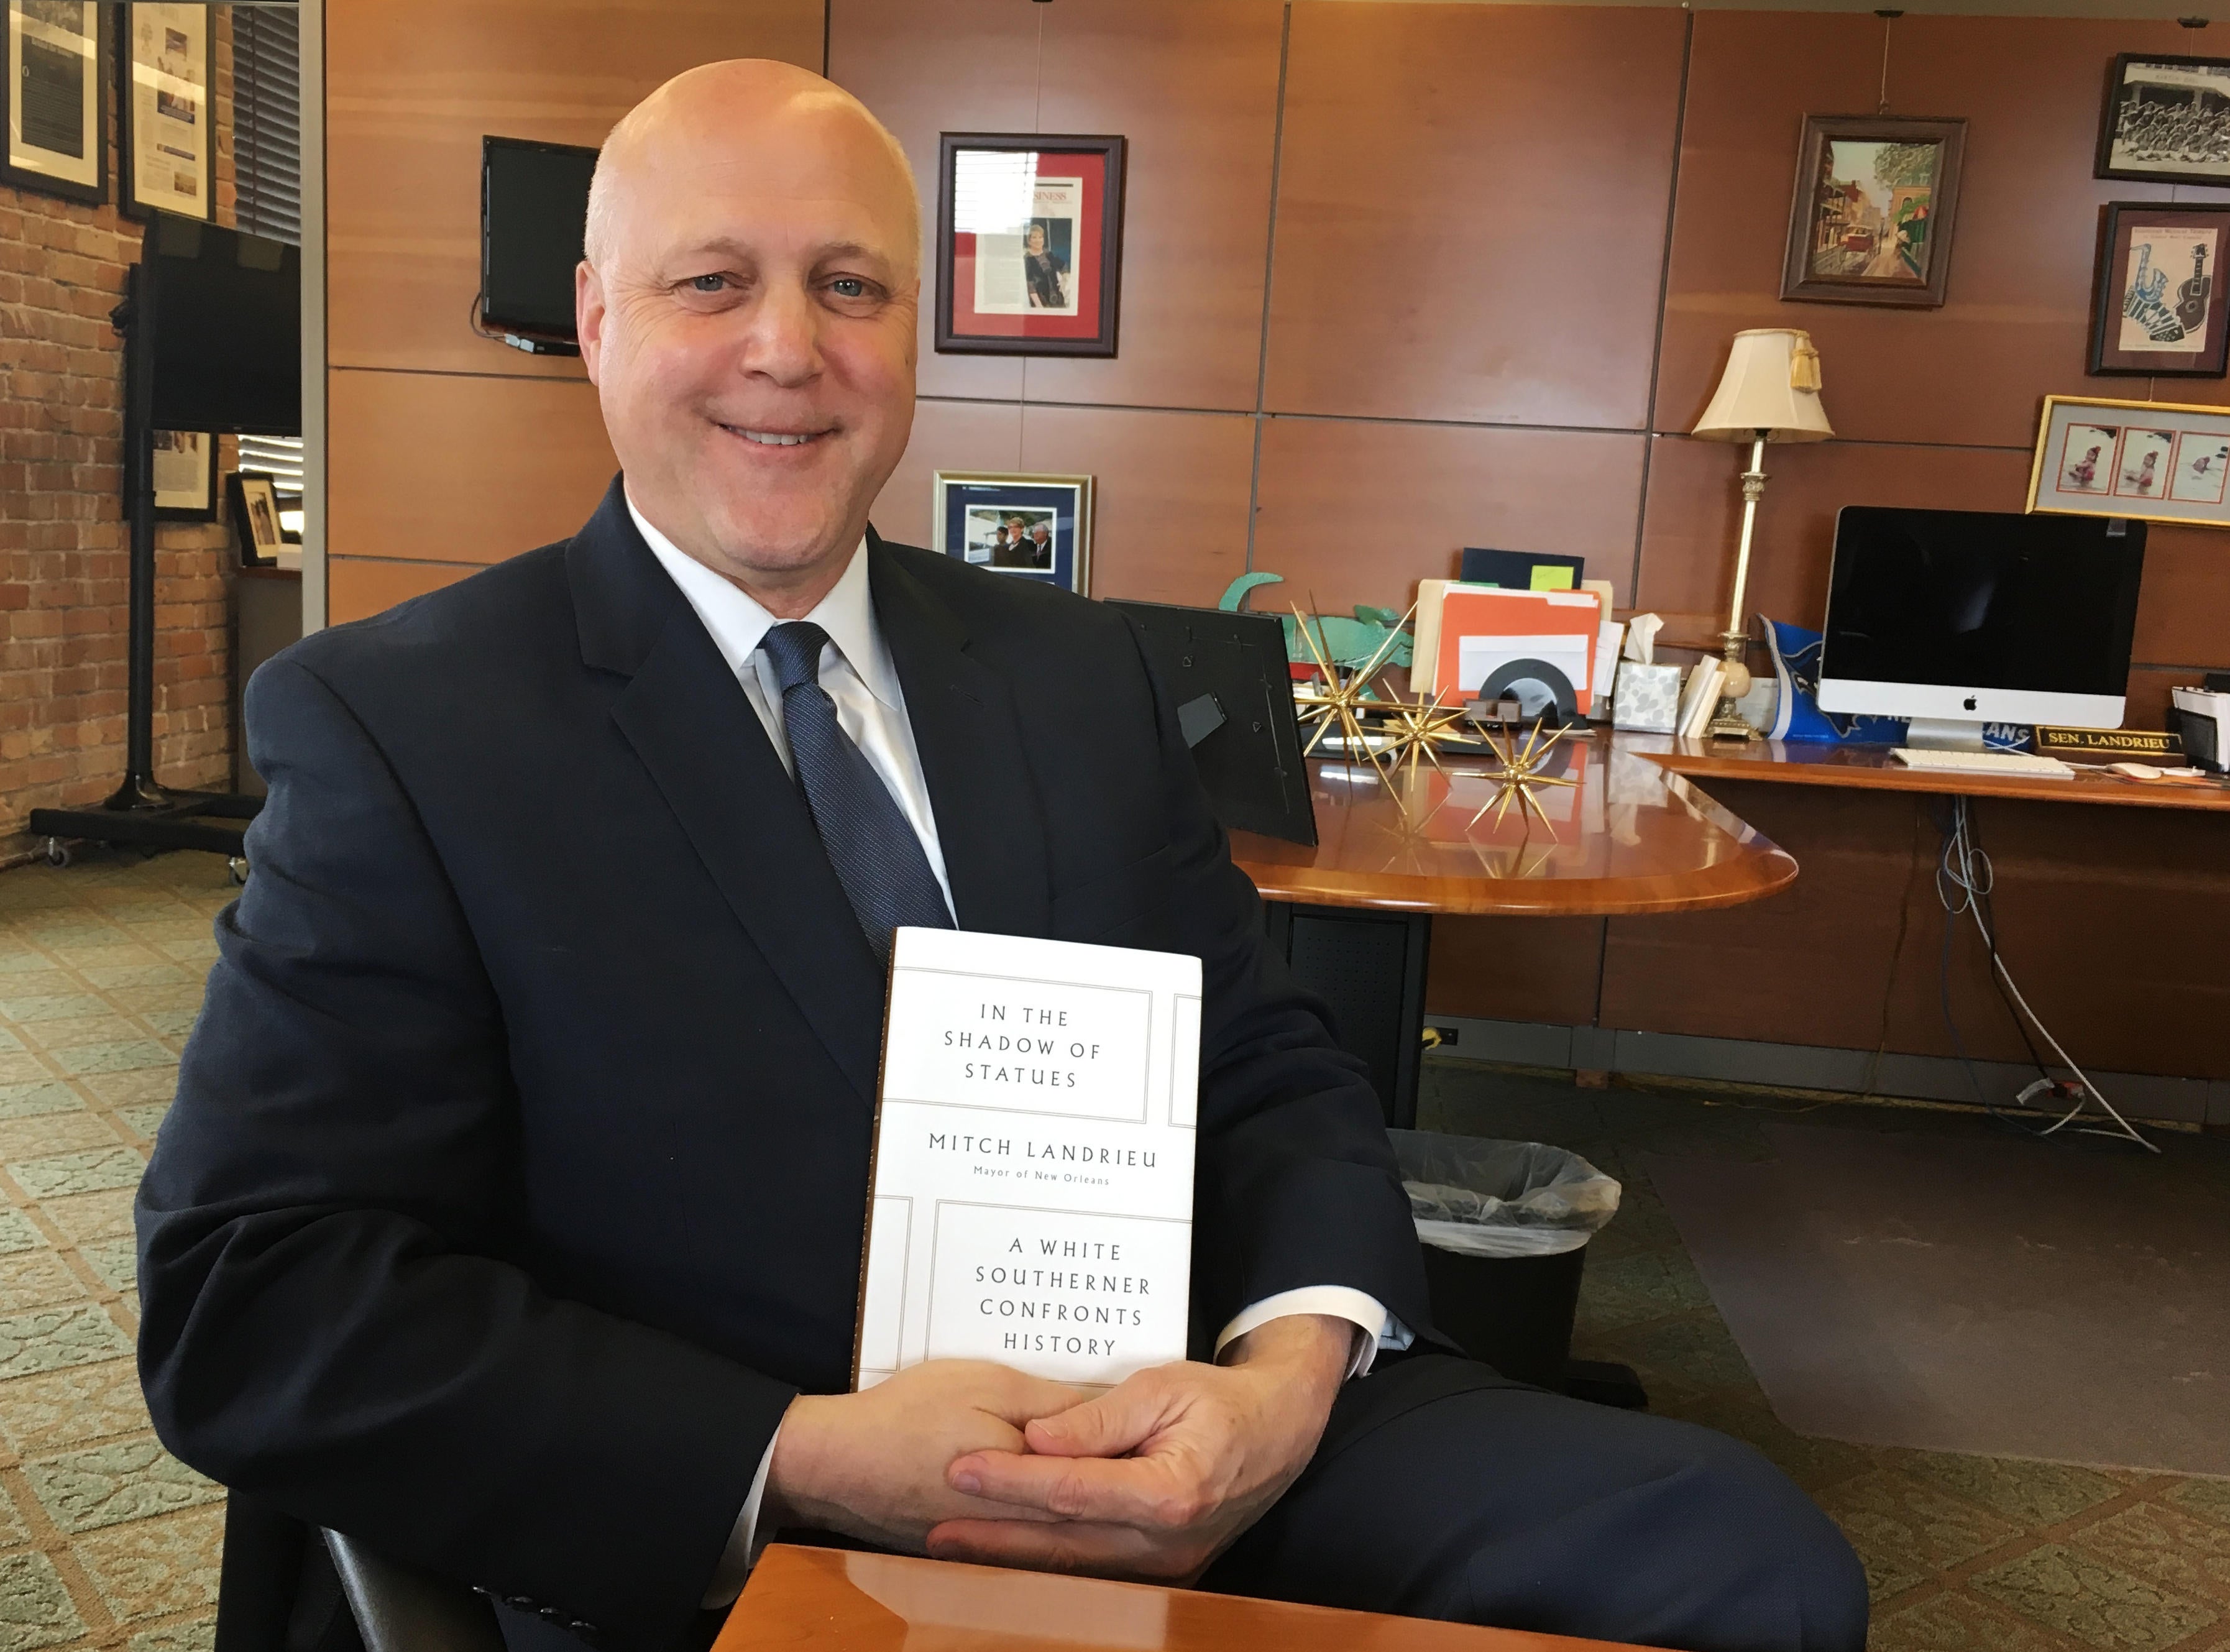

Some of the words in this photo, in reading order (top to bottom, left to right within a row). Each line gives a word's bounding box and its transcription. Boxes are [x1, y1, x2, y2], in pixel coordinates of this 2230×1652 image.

[1034, 191, 1067, 200] SINESS
[2049, 733, 2085, 744] SEN.
[2087, 735, 2170, 748] LANDRIEU
[981, 1004, 1006, 1021] IN
[1022, 1007, 1067, 1027] THE
[944, 1030, 1054, 1055] SHADOW
[1070, 1042, 1100, 1060] OF
[965, 1063, 1075, 1088] STATUES
[929, 1132, 1011, 1155] MITCH
[1027, 1141, 1156, 1168] LANDRIEU
[974, 1165, 1010, 1177] Mayor
[1016, 1170, 1029, 1179] of
[1035, 1171, 1058, 1181] New
[1063, 1173, 1109, 1186] Orleans
[1008, 1237, 1023, 1254] A
[1040, 1239, 1121, 1260] WHITE
[976, 1265, 1150, 1295] SOUTHERNER
[980, 1298, 1142, 1326] CONFRONTS
[1004, 1332, 1116, 1357] HISTORY
